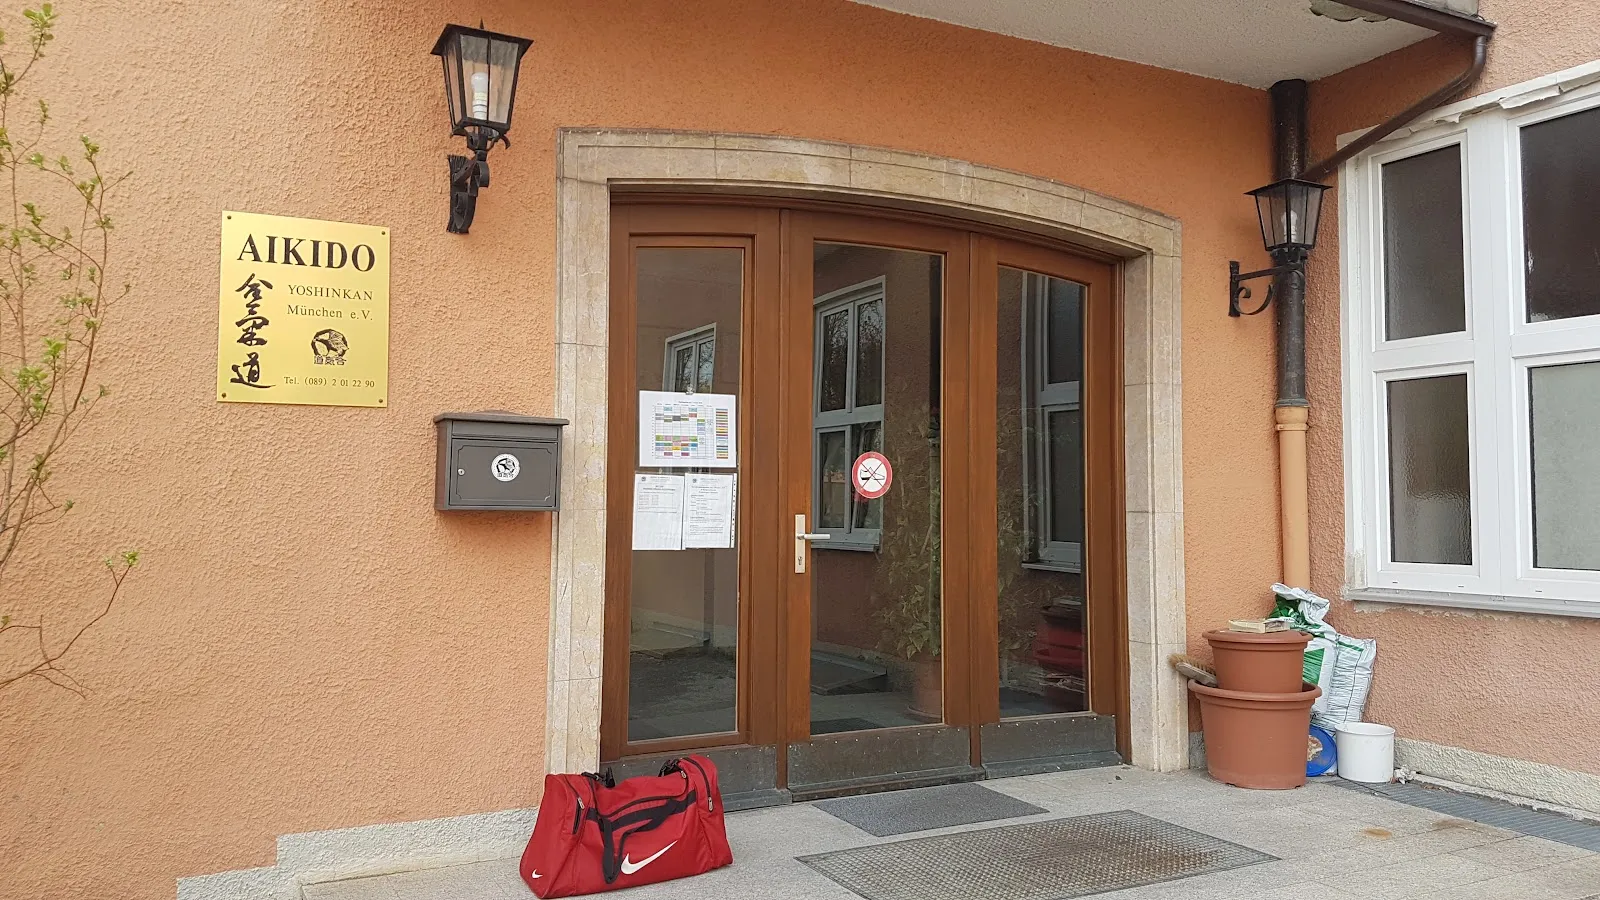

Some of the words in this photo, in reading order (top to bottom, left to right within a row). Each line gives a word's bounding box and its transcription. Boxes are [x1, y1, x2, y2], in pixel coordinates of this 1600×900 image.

[236, 233, 376, 272] AIKIDO
[288, 284, 373, 301] YOSHINKAN
[287, 304, 343, 318] München
[350, 309, 373, 321] e.V.
[284, 376, 300, 385] Tel.
[304, 377, 327, 387] (089)
[332, 378, 337, 386] 2
[340, 379, 349, 387] 01
[352, 379, 362, 387] 22
[365, 380, 375, 388] 90
